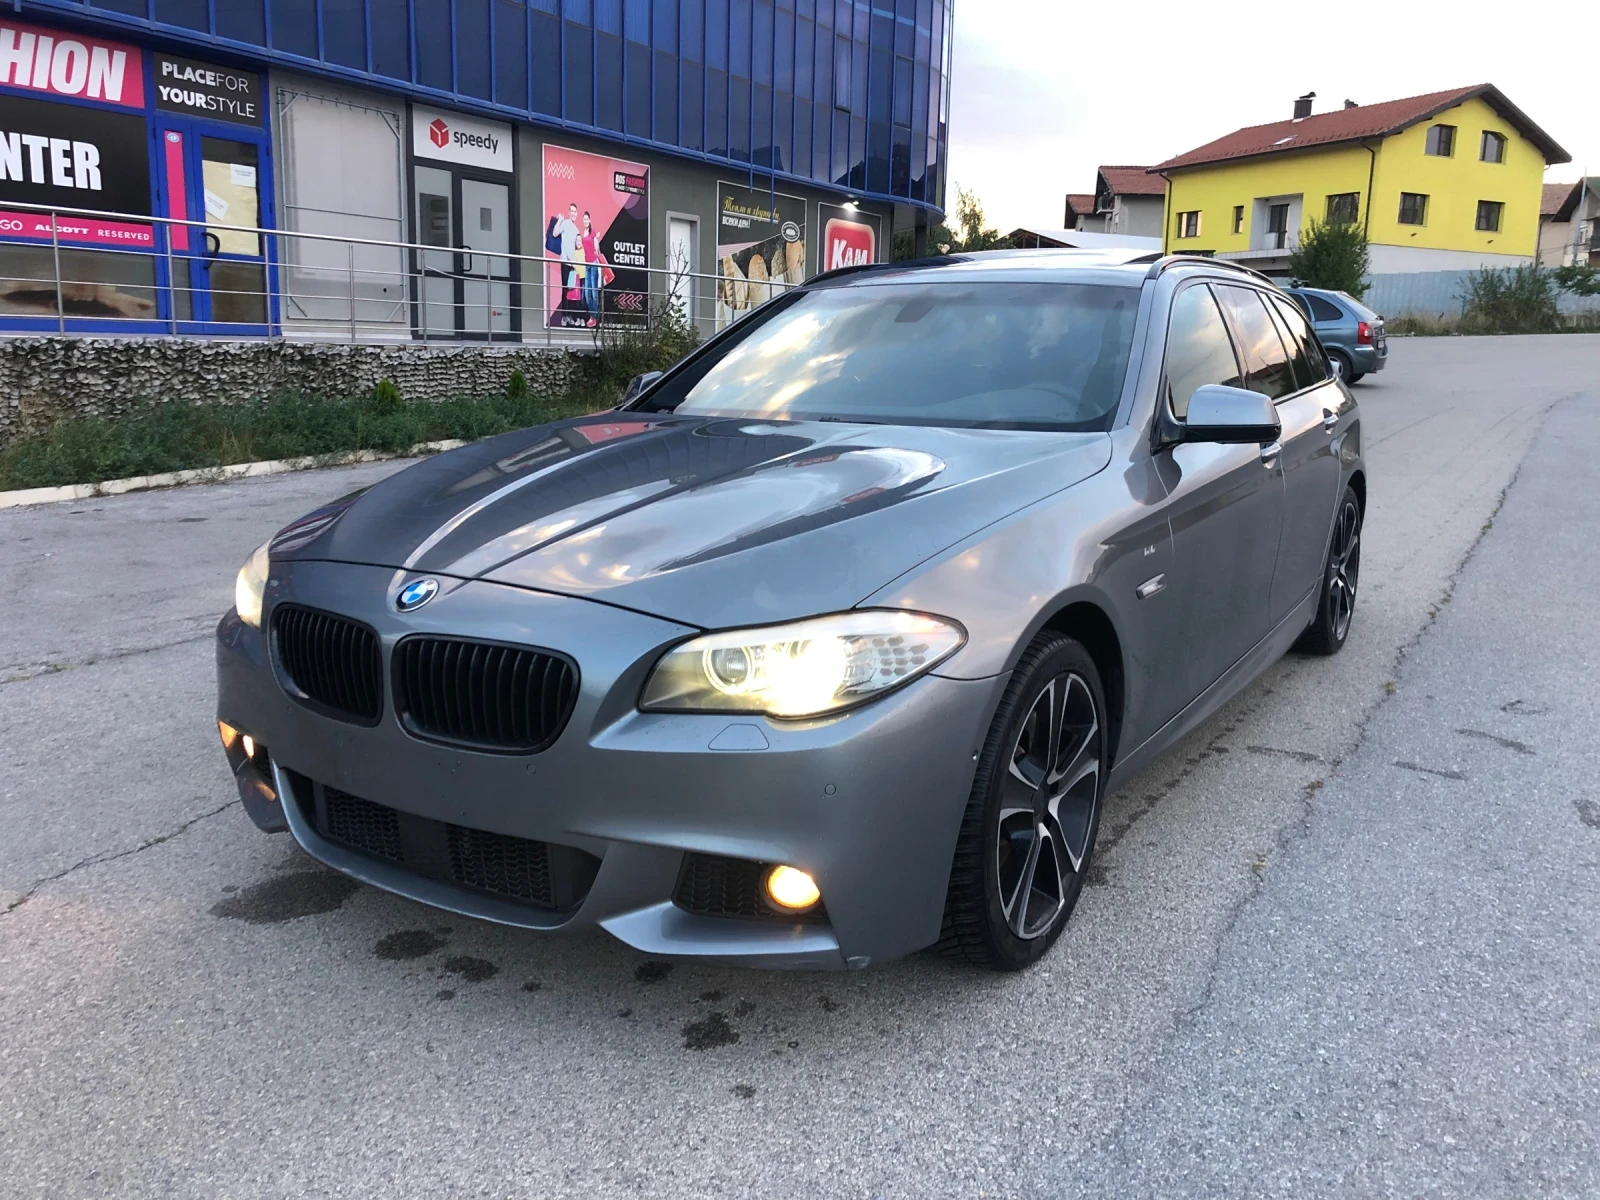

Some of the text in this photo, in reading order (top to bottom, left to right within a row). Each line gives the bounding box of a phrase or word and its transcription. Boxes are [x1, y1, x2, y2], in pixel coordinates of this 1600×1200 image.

[0, 28, 127, 102] HION
[453, 131, 499, 155] speedy
[0, 130, 102, 190] NTER
[97, 229, 150, 241] RESERVED
[613, 241, 645, 255] OUTLET
[613, 253, 645, 266] CENTER
